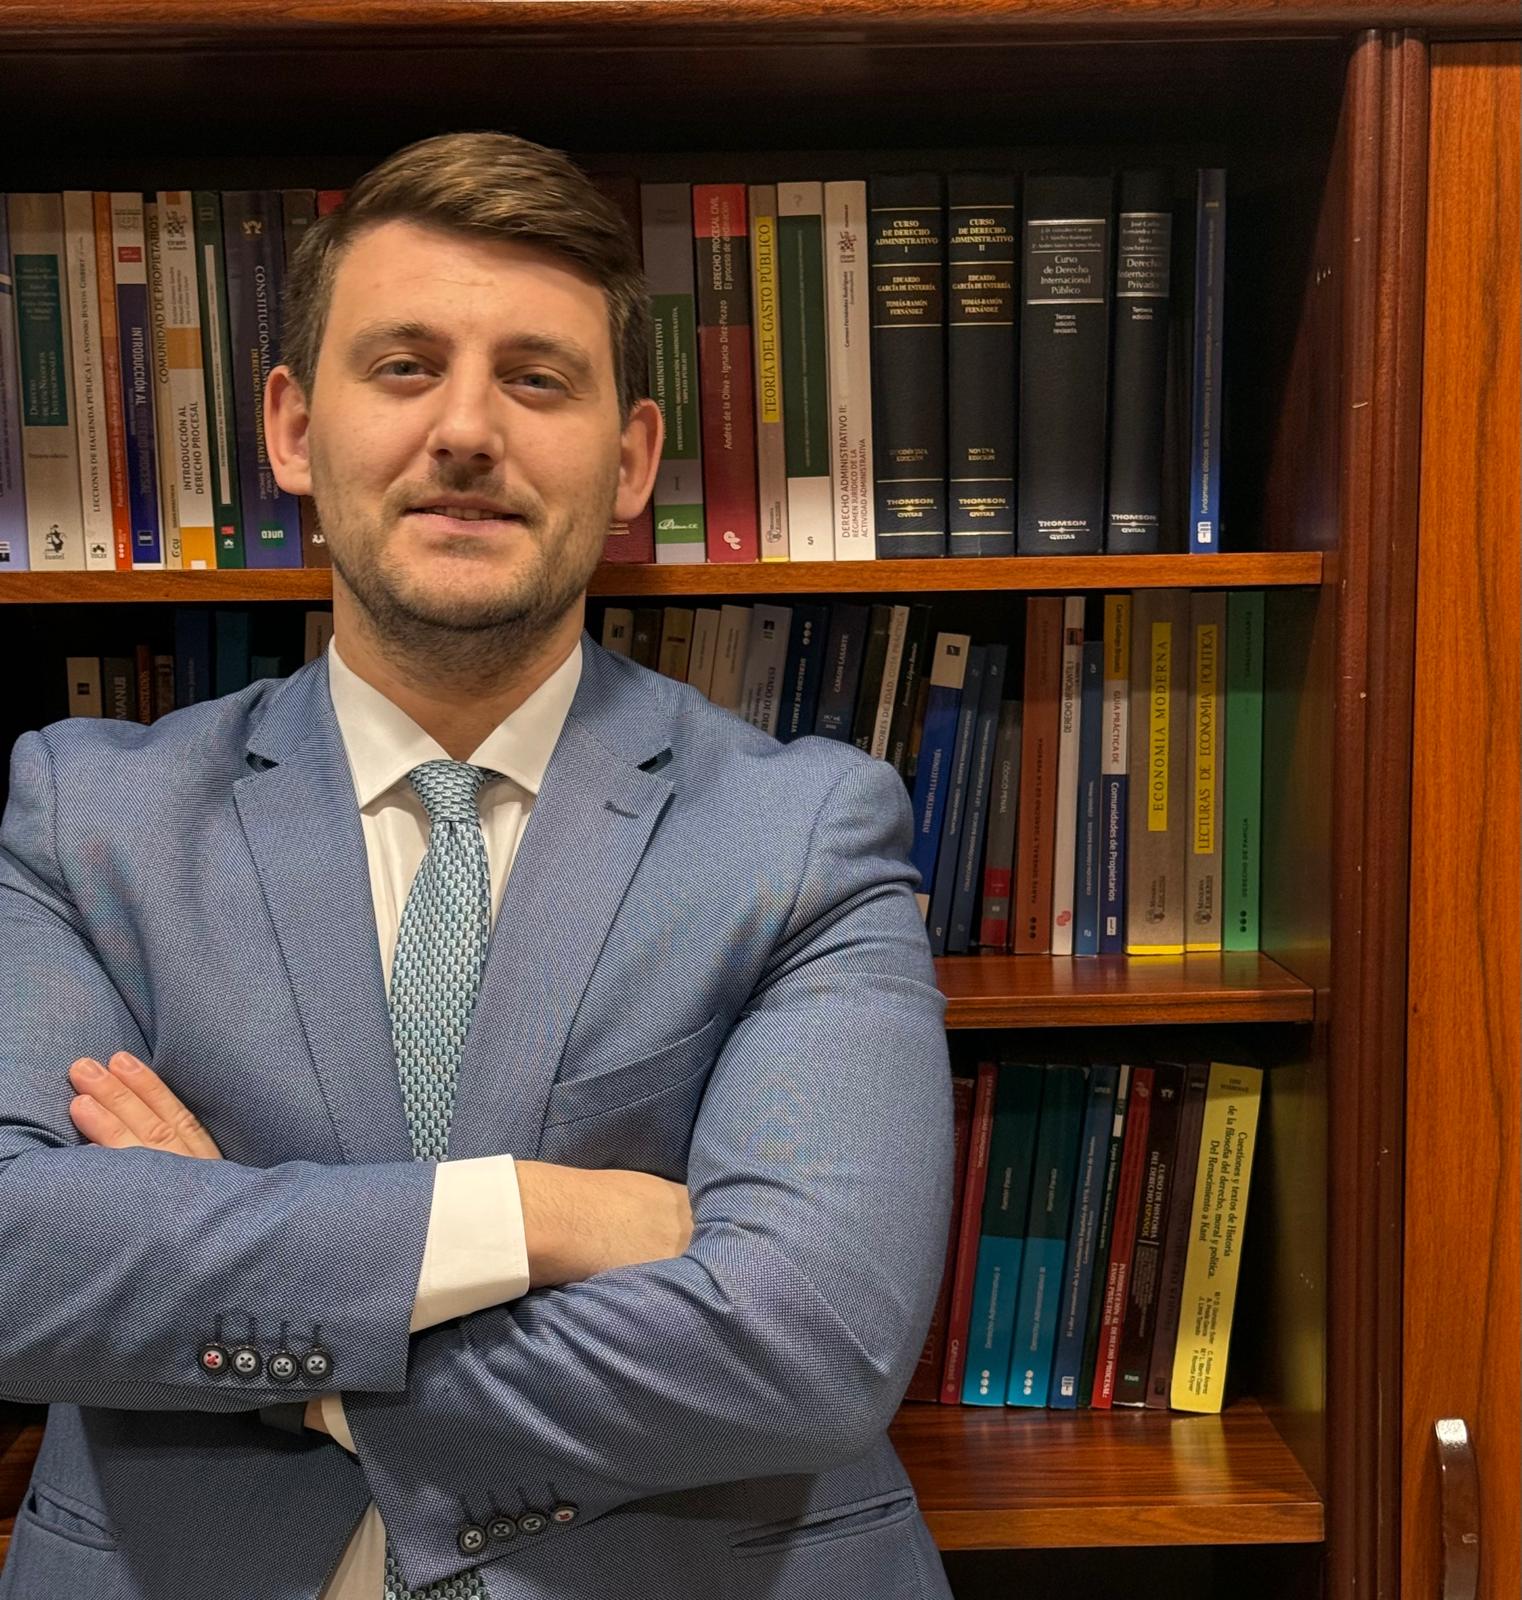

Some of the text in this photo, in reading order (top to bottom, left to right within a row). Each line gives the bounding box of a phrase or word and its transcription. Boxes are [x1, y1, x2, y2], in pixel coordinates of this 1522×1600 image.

[882, 228, 931, 237] DE DERECHO
[893, 220, 920, 228] CURSO
[958, 226, 1006, 235] DE DERECHO
[969, 218, 996, 226] CURSO
[710, 196, 722, 290] DERECHO PROCESAL CIVIL
[722, 243, 731, 252] de
[875, 237, 939, 246] ADMINISTRATIVO
[950, 235, 1014, 244] ADMINISTRATIVO
[724, 254, 734, 282] proceso
[1043, 266, 1089, 274] de Derecho
[1054, 255, 1078, 264] Curso
[1040, 276, 1091, 284] Internacional
[1051, 286, 1081, 295] Público
[149, 215, 169, 384] COMUNIDAD DE PROPIETARIOS
[756, 224, 776, 415] TEORÍA DEL GASTO PÚBLICO
[132, 327, 148, 392] INTRODUCCIÓN
[654, 323, 666, 398] ADMINISTRATIVO
[720, 346, 730, 374] Ignacio
[134, 394, 146, 406] AL
[721, 380, 730, 400] Oliva
[87, 406, 96, 451] HACIENDA
[722, 410, 731, 422] de
[178, 406, 192, 490] INTRODUCCIÓN AL
[189, 402, 204, 494] DERECHO PROCESAL
[722, 424, 732, 449] Andrés
[90, 453, 98, 464] DE
[838, 415, 849, 492] ADMINISTRATIVO
[851, 460, 858, 469] DE
[92, 466, 102, 512] LECCIONES
[859, 438, 868, 538] ACTIVIDAD ADMINISTRATIVA
[840, 494, 850, 538] DERECHO
[834, 666, 844, 692] CARLOS
[1154, 641, 1167, 718] MODERNA
[881, 706, 890, 718] DE
[1063, 664, 1074, 733] DERECHO MERCANTIL
[790, 702, 800, 733] FAMILIA
[1112, 690, 1122, 764] GUÍA PRÁCTICA DE
[1200, 768, 1210, 780] DE
[1198, 788, 1210, 848] LECTURAS
[1107, 782, 1120, 901] Comunidades de Propietarios
[1228, 1105, 1238, 1116] de
[1210, 1140, 1220, 1155] Del
[1233, 1132, 1248, 1176] Cuestiones
[1220, 1160, 1231, 1174] del
[1146, 1166, 1158, 1204] DERECHO
[1202, 1156, 1218, 1212] Renacimiento
[1214, 1176, 1230, 1211] derecho,
[1150, 1164, 1166, 1238] CURSO DE HISTORIA
[1229, 1186, 1240, 1211] textos
[1142, 1204, 1155, 1237] ESPAÑOL
[1198, 1222, 1211, 1242] Kant
[1212, 1214, 1224, 1238] moral
[1227, 1213, 1238, 1224] de
[1224, 1225, 1236, 1256] Historia
